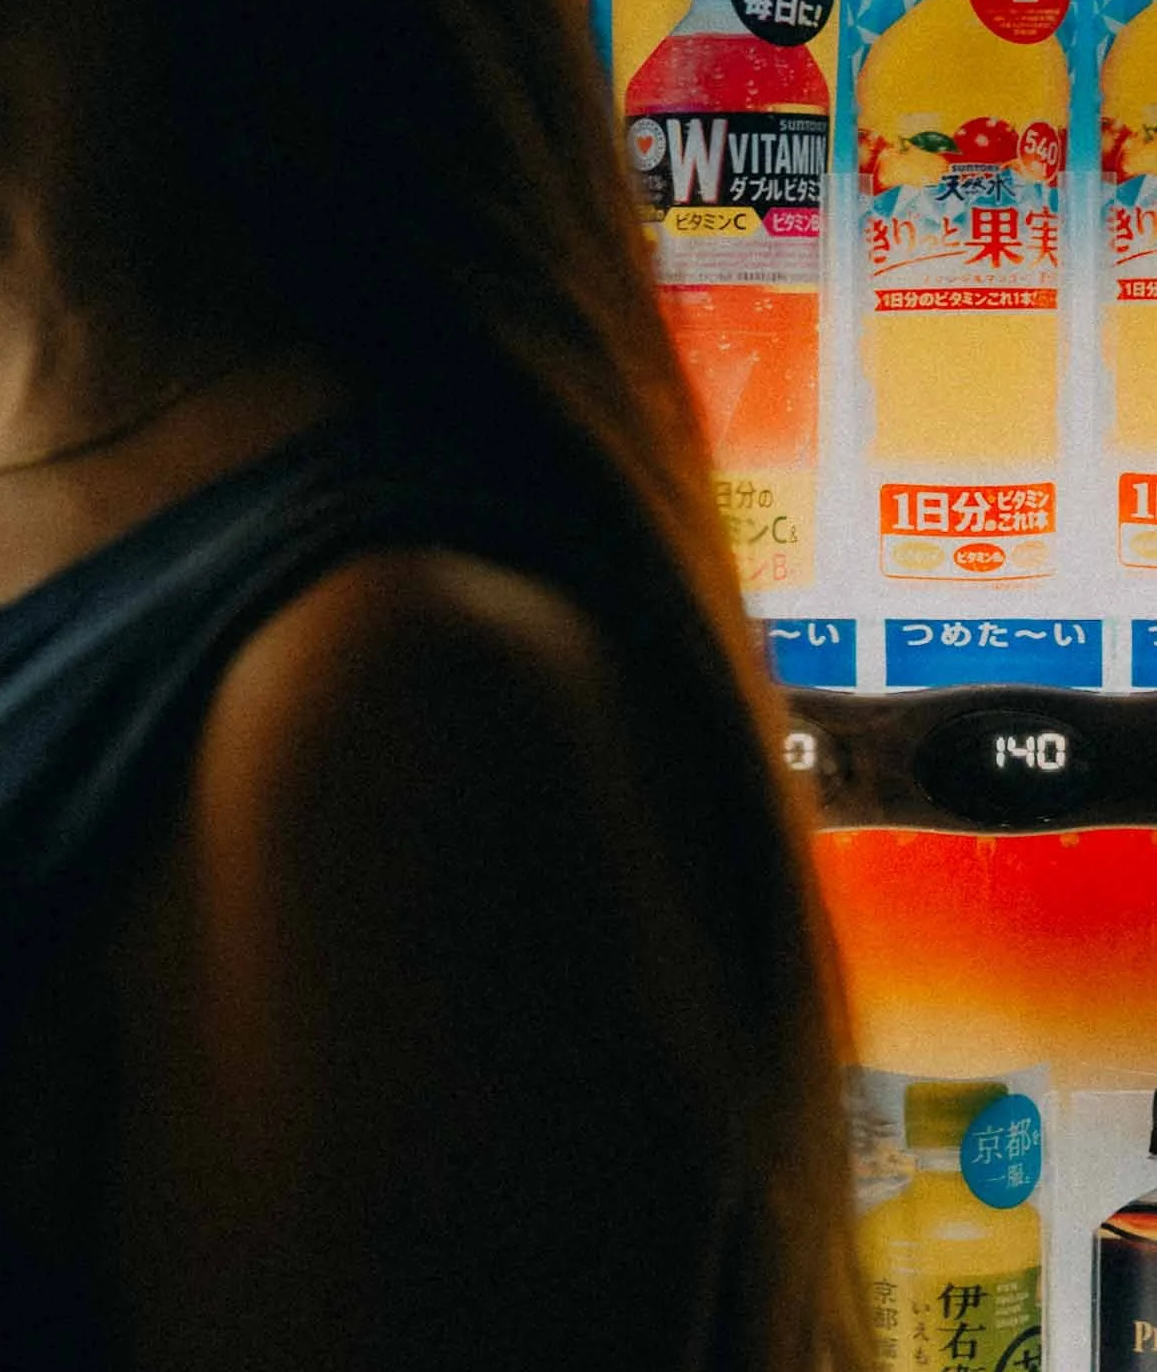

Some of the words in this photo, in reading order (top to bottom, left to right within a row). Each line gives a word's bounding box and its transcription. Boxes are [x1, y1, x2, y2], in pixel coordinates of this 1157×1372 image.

[665, 116, 730, 205] W
[727, 132, 827, 176] VITAMIN
[1023, 129, 1060, 169] 540
[675, 212, 748, 232] ビタミンC
[994, 732, 1068, 771] 140
[971, 1117, 1033, 1166] 京都
